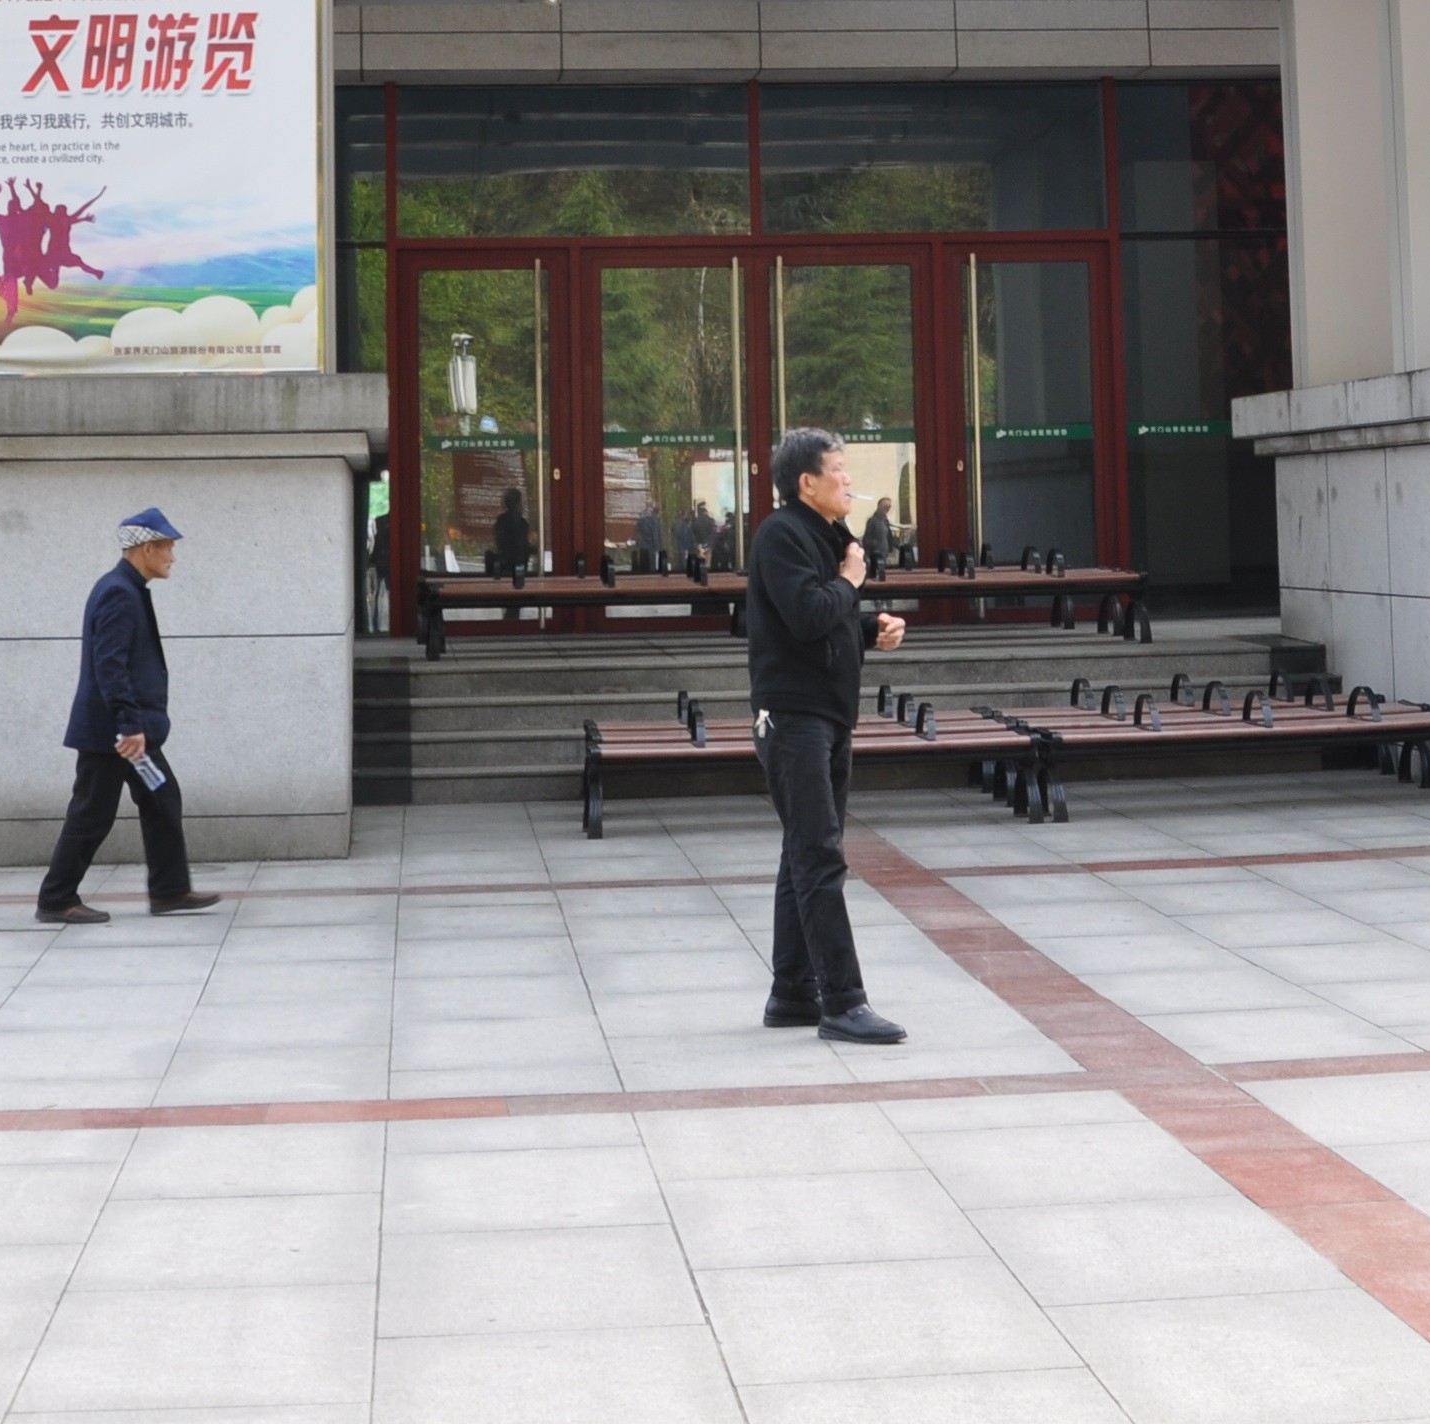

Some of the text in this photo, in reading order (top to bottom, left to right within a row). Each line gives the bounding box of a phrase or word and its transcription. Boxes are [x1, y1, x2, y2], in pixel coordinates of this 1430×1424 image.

[21, 12, 259, 93] 文明游览
[9, 142, 37, 153] heart,
[39, 142, 49, 152] in
[51, 141, 90, 154] practice
[92, 141, 102, 151] in
[104, 141, 120, 151] the
[11, 155, 39, 164] create
[41, 156, 47, 164] a
[48, 154, 84, 164] civilized
